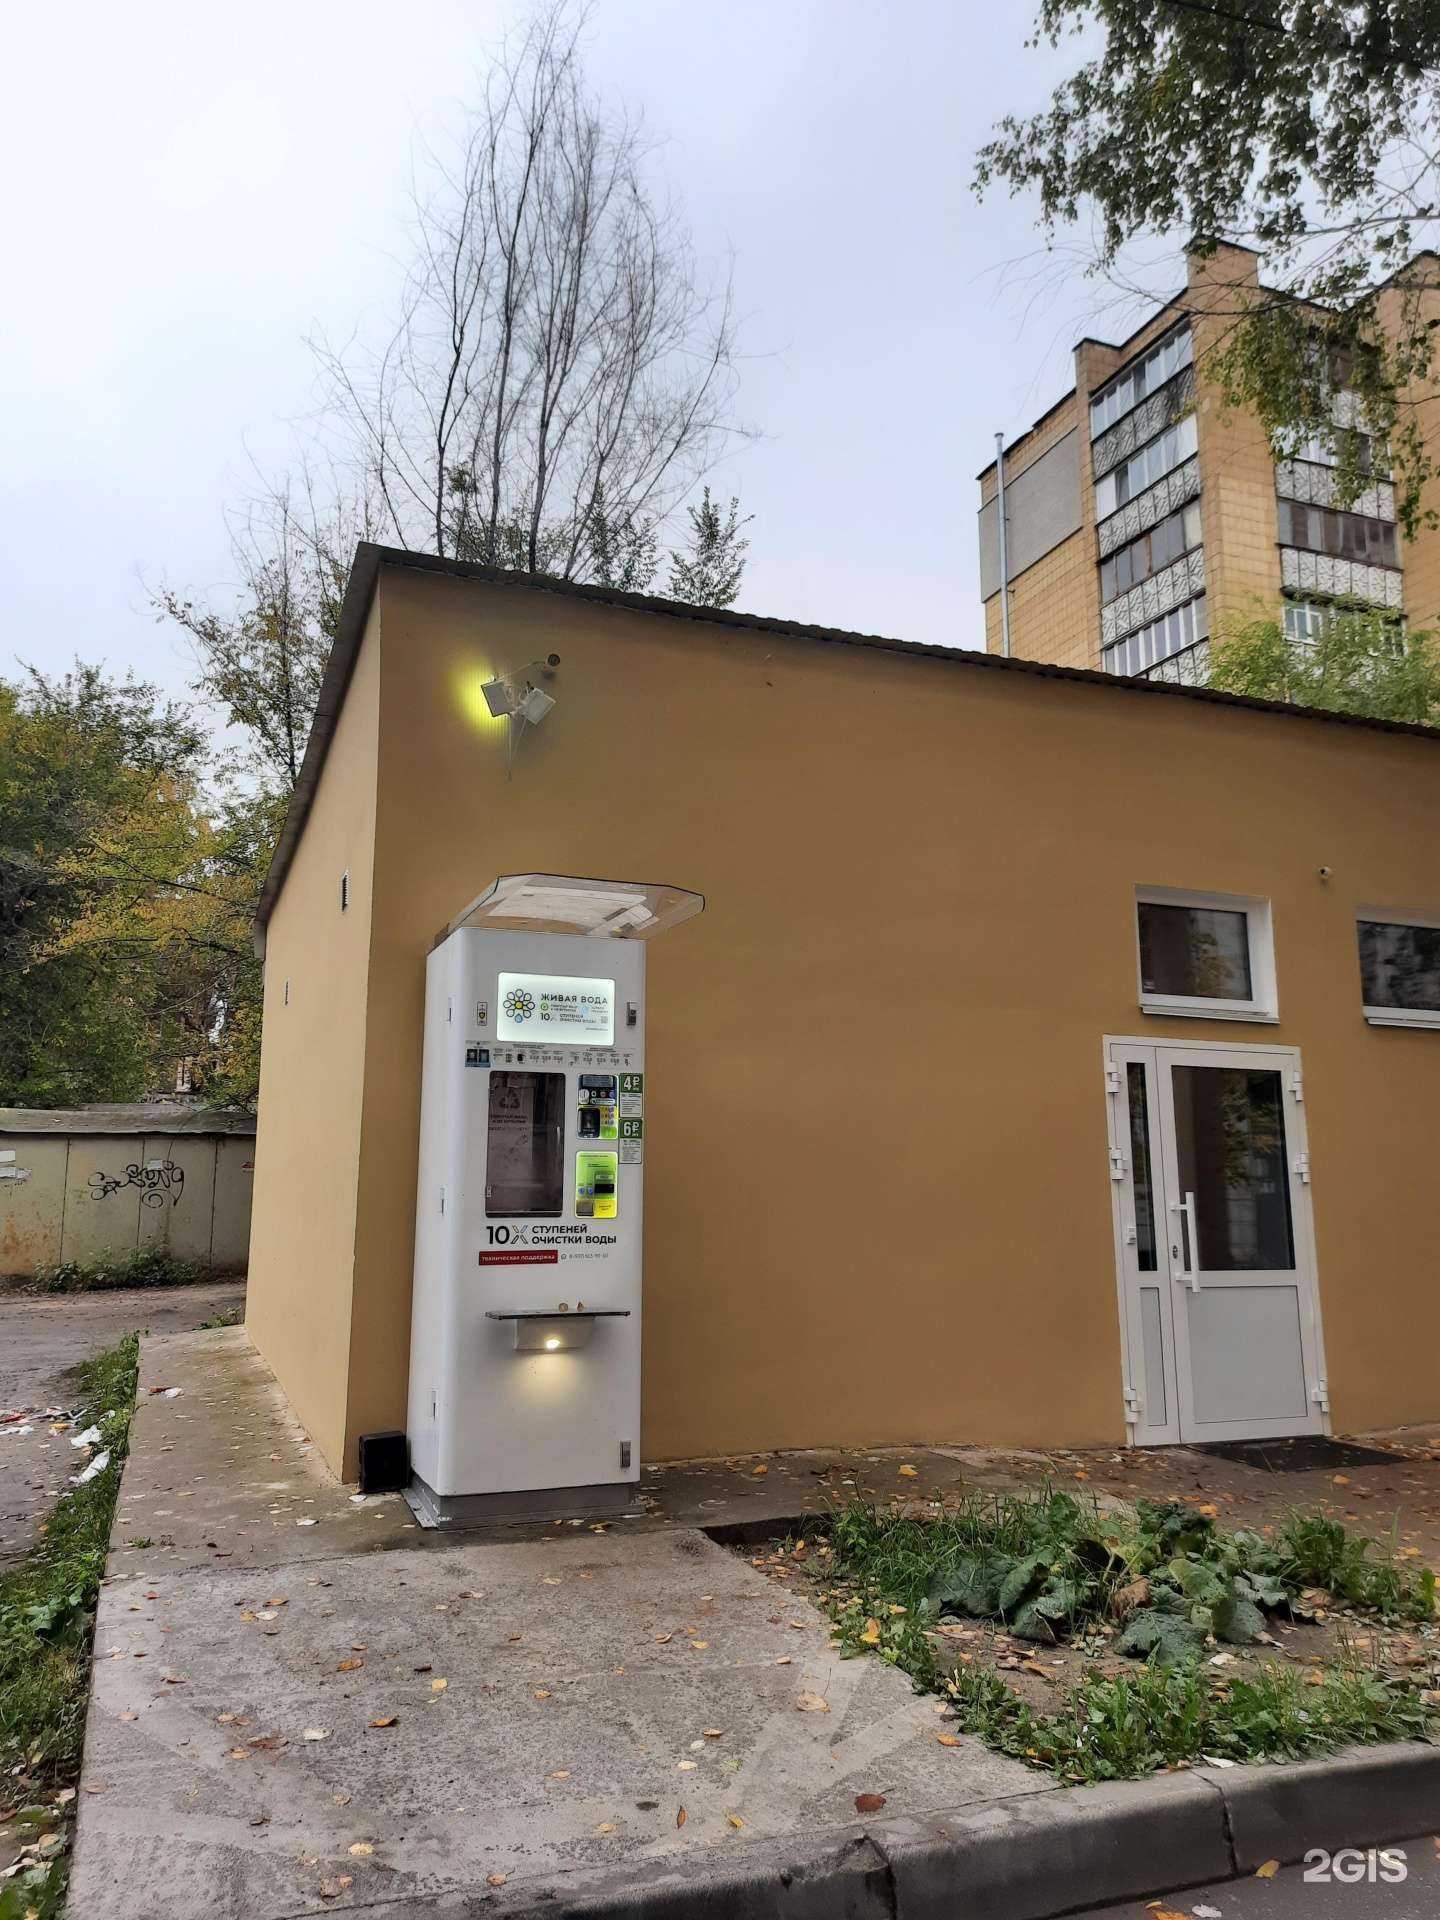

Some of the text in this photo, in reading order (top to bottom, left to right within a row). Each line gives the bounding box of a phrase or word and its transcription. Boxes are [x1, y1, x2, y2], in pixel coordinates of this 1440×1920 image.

[541, 993, 608, 1004] ЖИВАЯ ВОДА
[531, 1224, 588, 1234] СТУПЕНЕЙ
[531, 1235, 617, 1245] ОЧИСТКИ ВОДЫ
